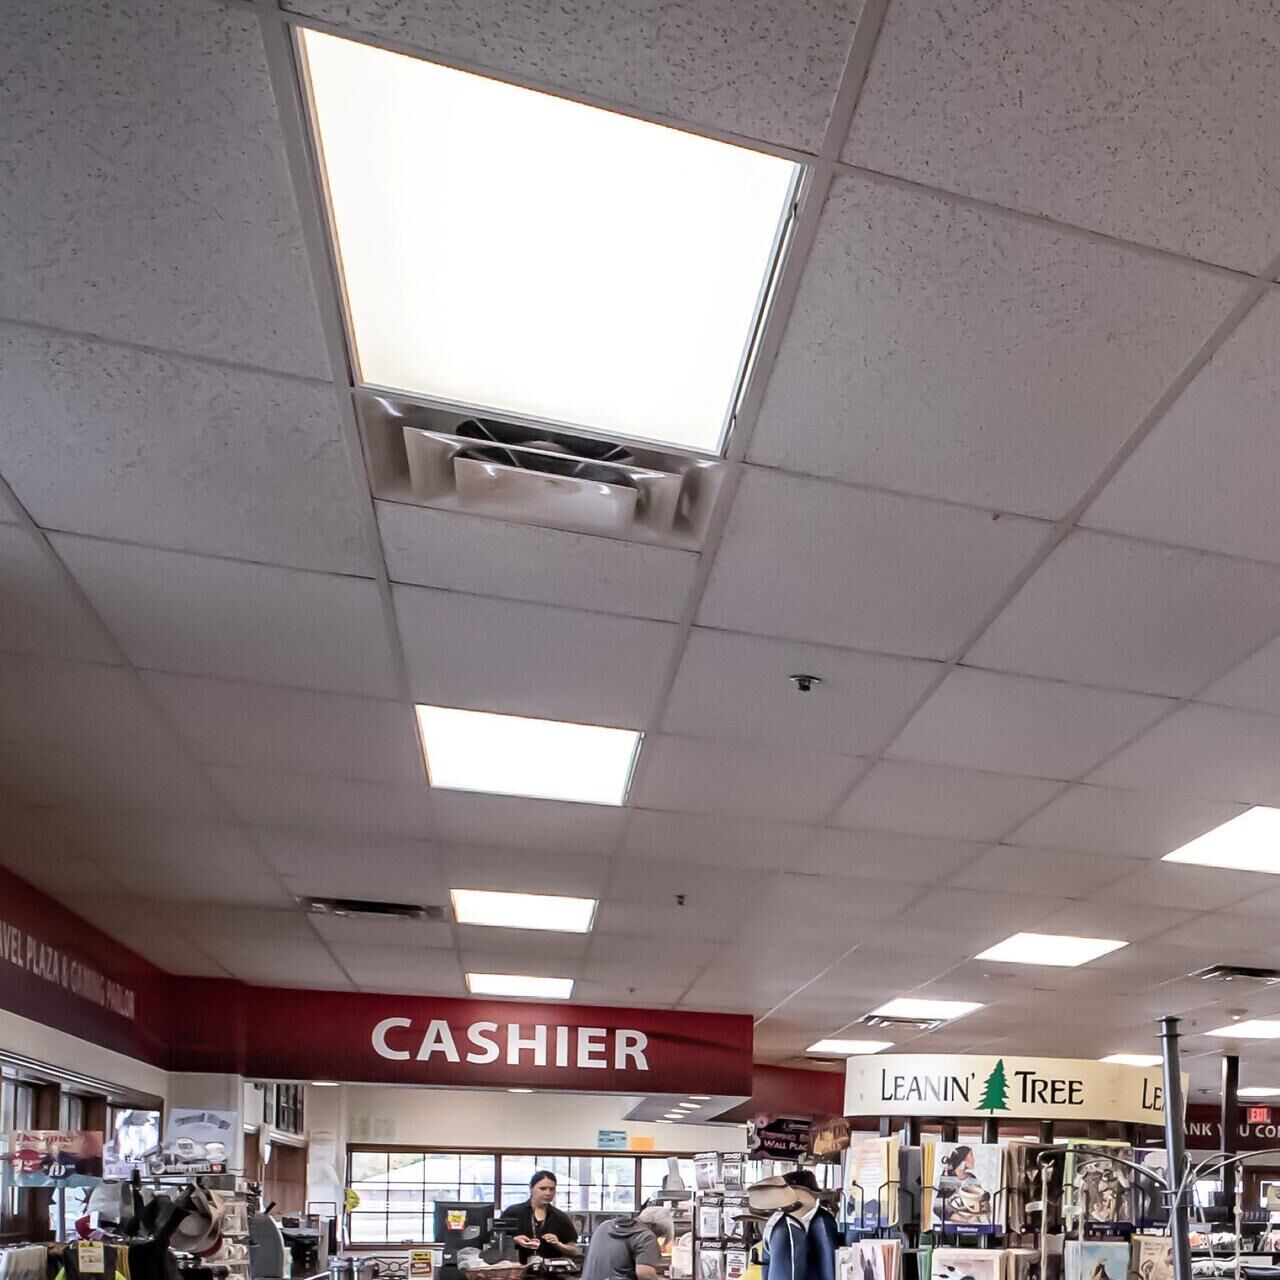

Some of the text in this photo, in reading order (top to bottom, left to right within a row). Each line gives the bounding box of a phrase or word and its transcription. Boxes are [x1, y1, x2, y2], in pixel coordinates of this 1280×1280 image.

[26, 935, 60, 985] PLAZA
[371, 1016, 649, 1071] CASHIER
[881, 1068, 1084, 1105] LEANIN' TREE
[1250, 1108, 1269, 1122] EXIT
[764, 1140, 787, 1150] WALL
